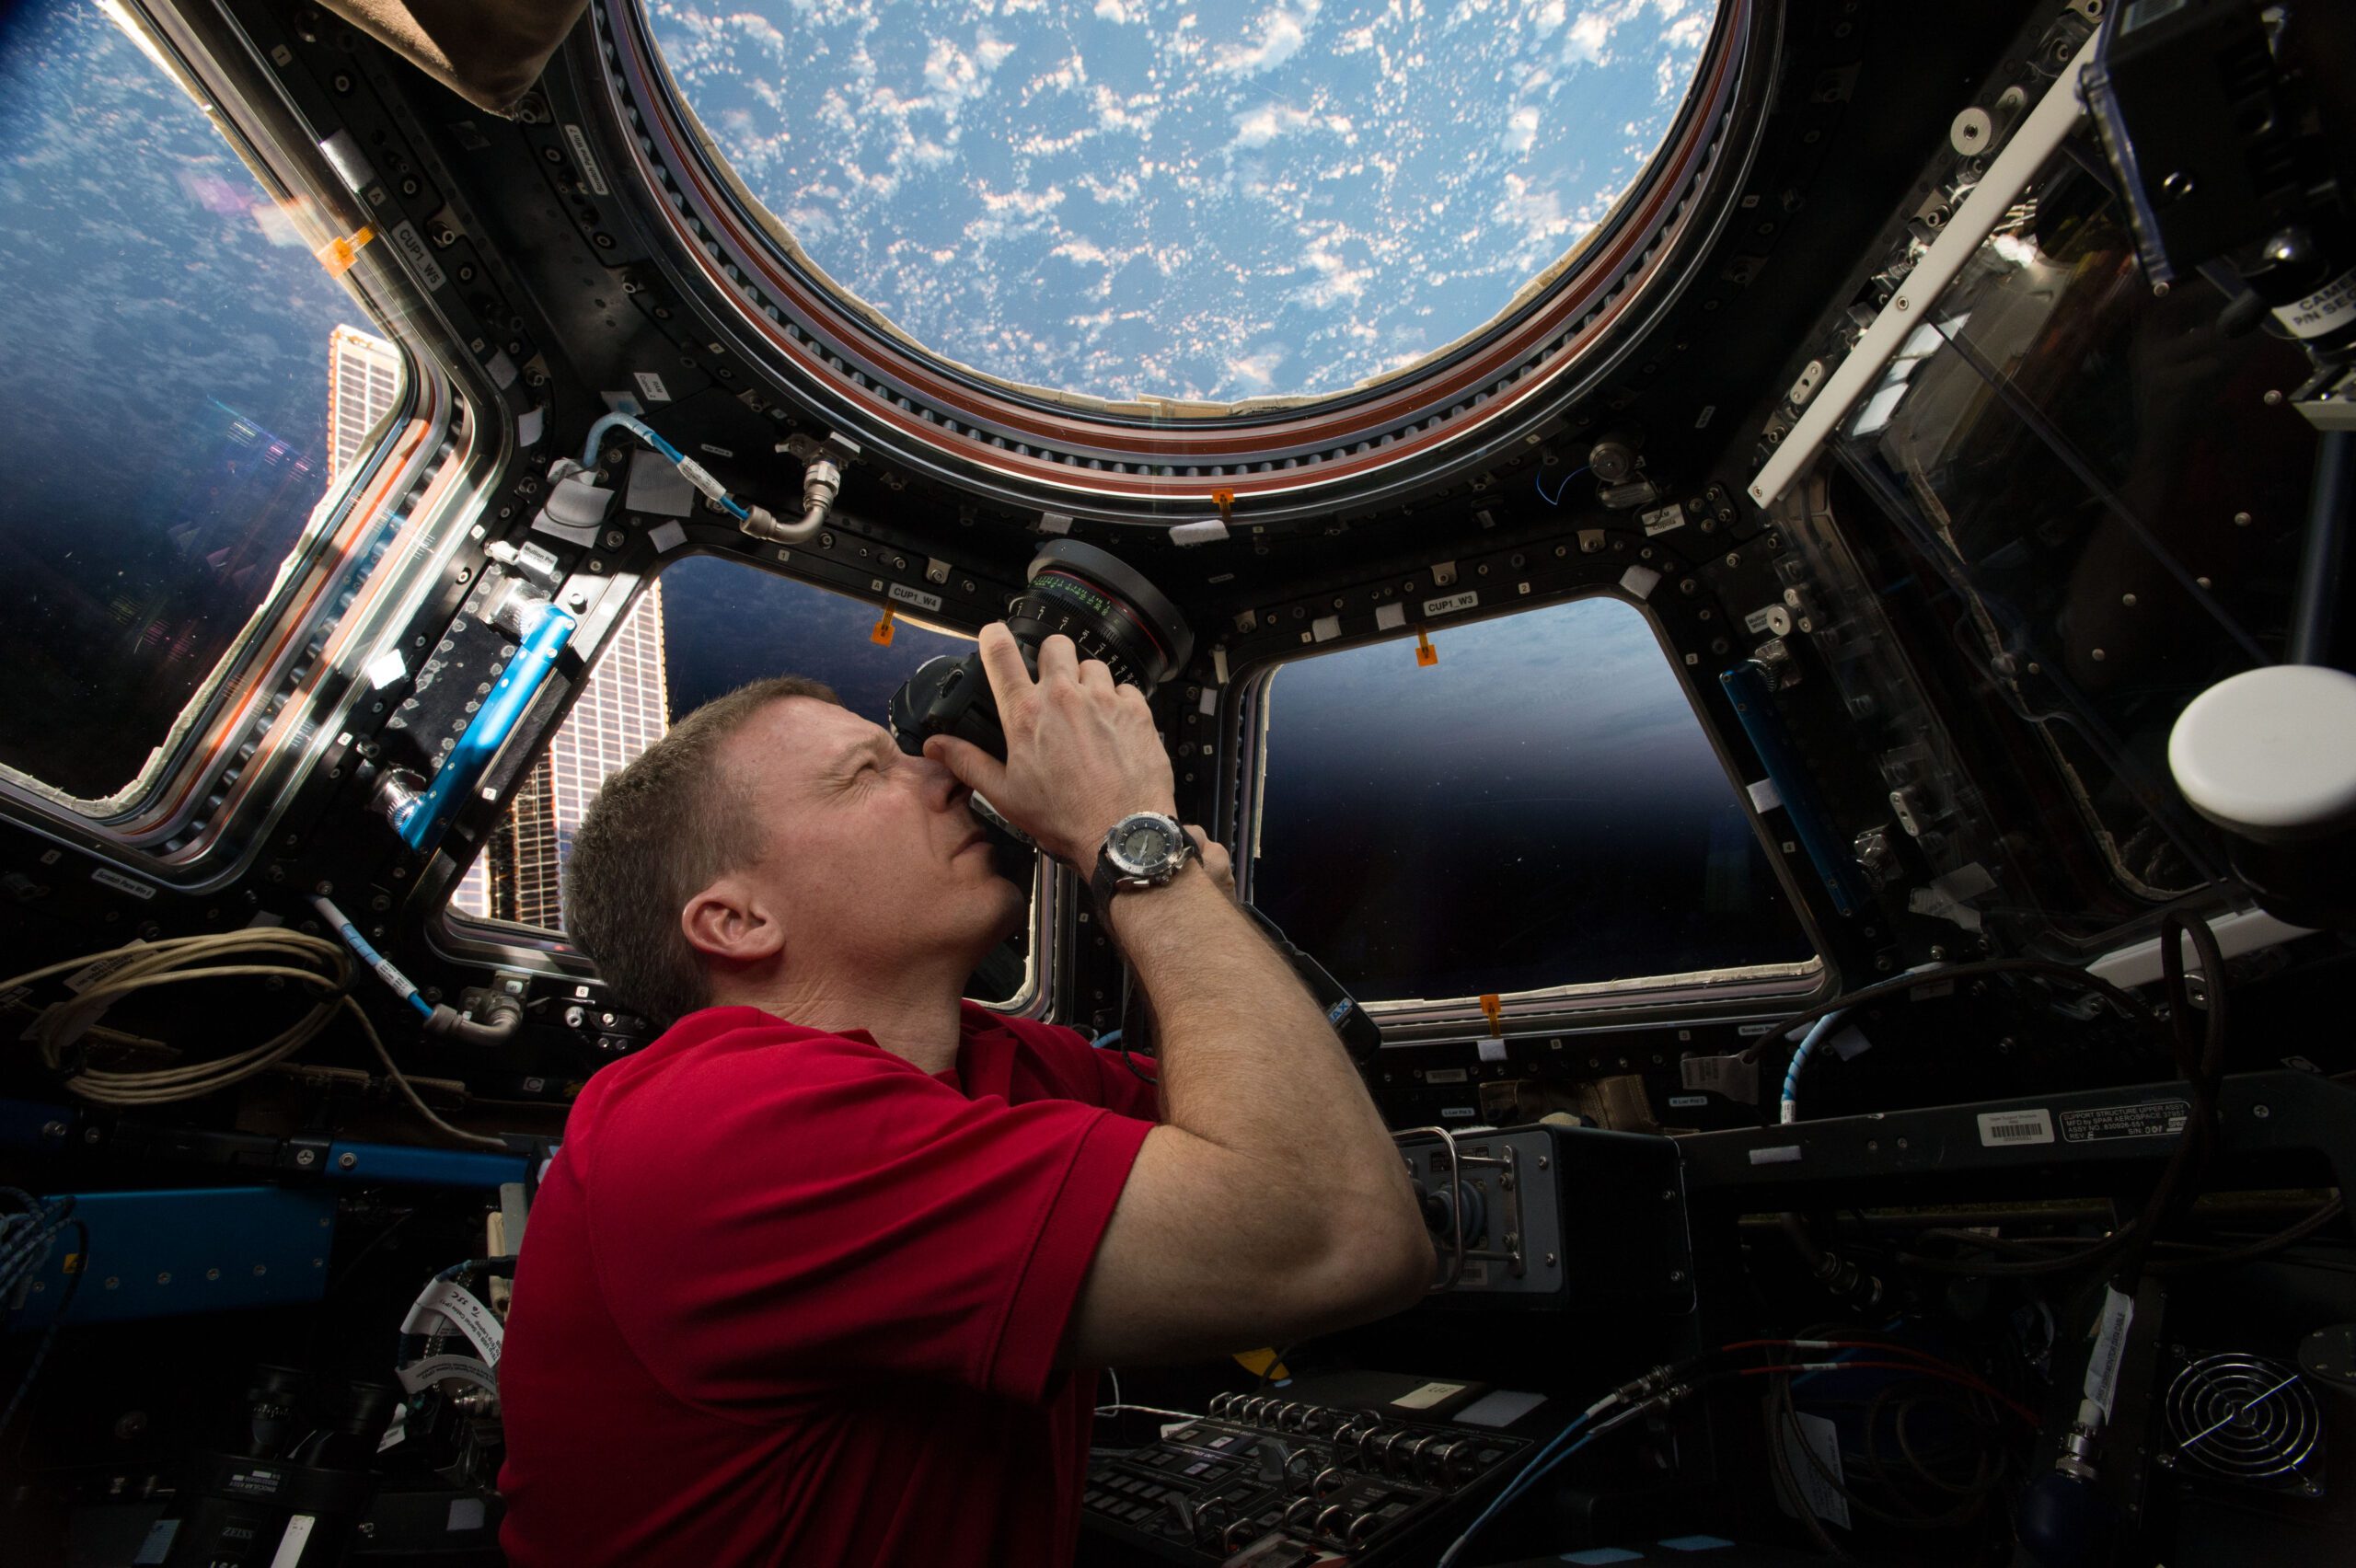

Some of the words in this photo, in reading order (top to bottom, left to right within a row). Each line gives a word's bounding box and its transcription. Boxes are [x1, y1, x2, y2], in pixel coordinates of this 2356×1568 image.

[399, 229, 441, 284] CUP1_W5
[525, 545, 545, 559] Mullion
[894, 587, 937, 607] CUP1_W4
[1427, 595, 1473, 613] CUP1_W3
[527, 1078, 543, 1090] C
[2063, 1112, 2096, 1121] SUPPORT
[2096, 1108, 2137, 1119] STRUCTURE
[2139, 1105, 2164, 1114] UPPER
[2093, 1116, 2113, 1125] SPAR
[2114, 1113, 2161, 1123] AEROSPACE
[2068, 1126, 2086, 1135] ASSY
[451, 1306, 465, 1320] Cable
[463, 1318, 477, 1332] Serial
[474, 1320, 489, 1337] Laptop
[479, 1337, 490, 1348] USB
[2104, 1346, 2117, 1372] MONITOR
[2115, 1312, 2126, 1332] CABLE
